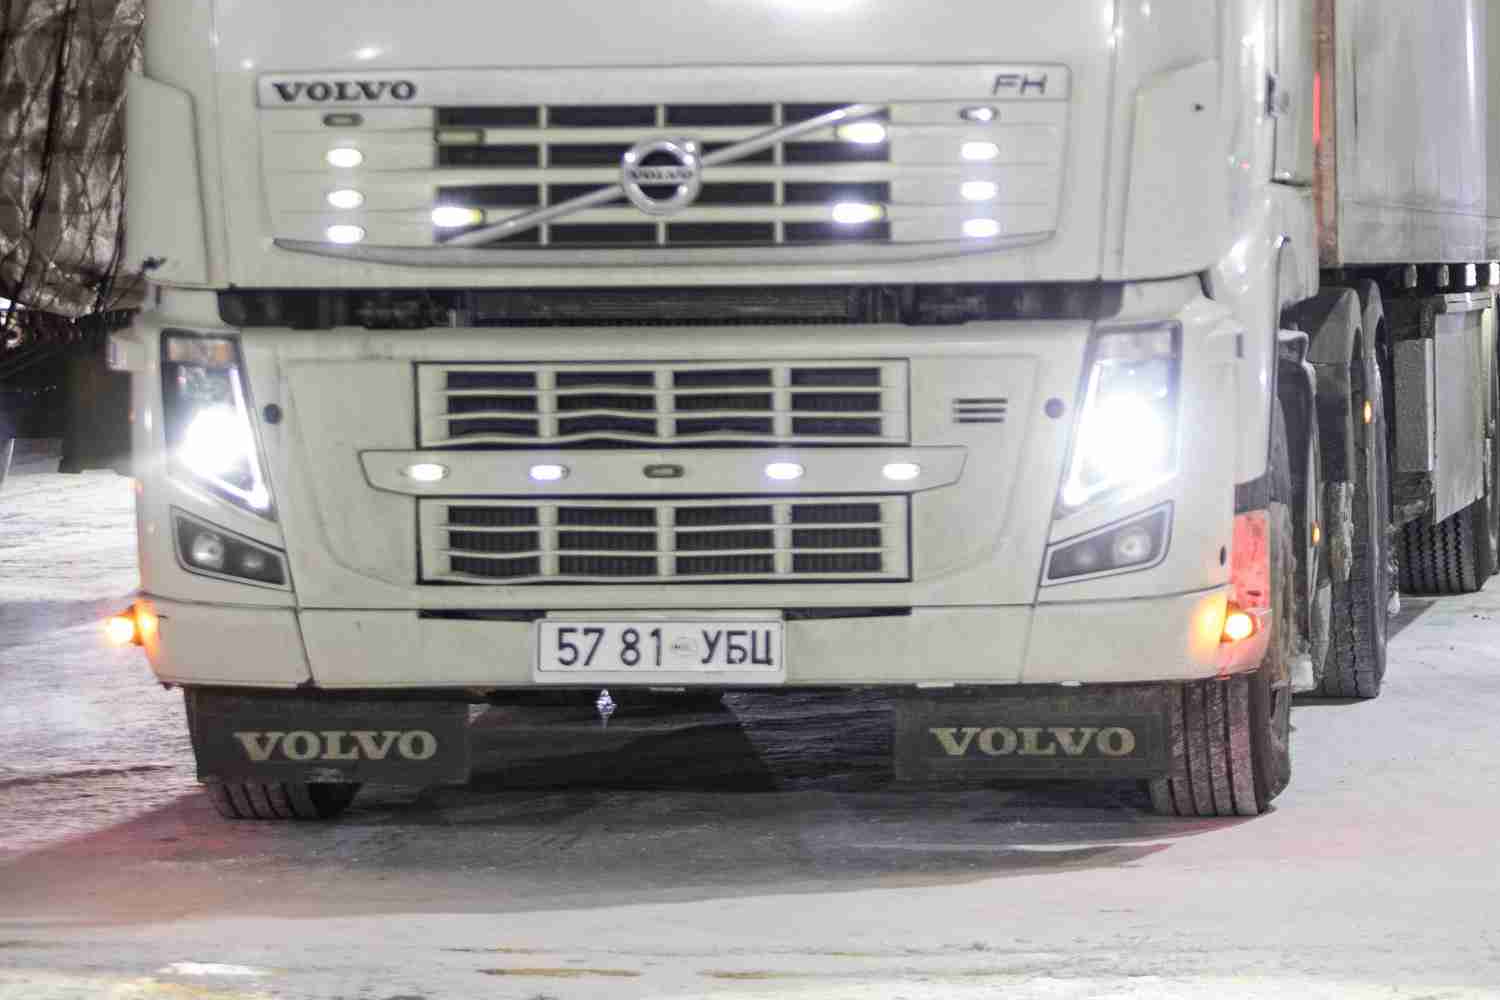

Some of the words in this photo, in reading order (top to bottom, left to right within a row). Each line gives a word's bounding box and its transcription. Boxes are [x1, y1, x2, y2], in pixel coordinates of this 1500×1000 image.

[272, 80, 416, 102] VOLVO
[992, 74, 1048, 96] FH
[701, 630, 774, 666] УБЦ
[232, 730, 437, 761] VOLVO
[928, 726, 1136, 756] VOLVO
